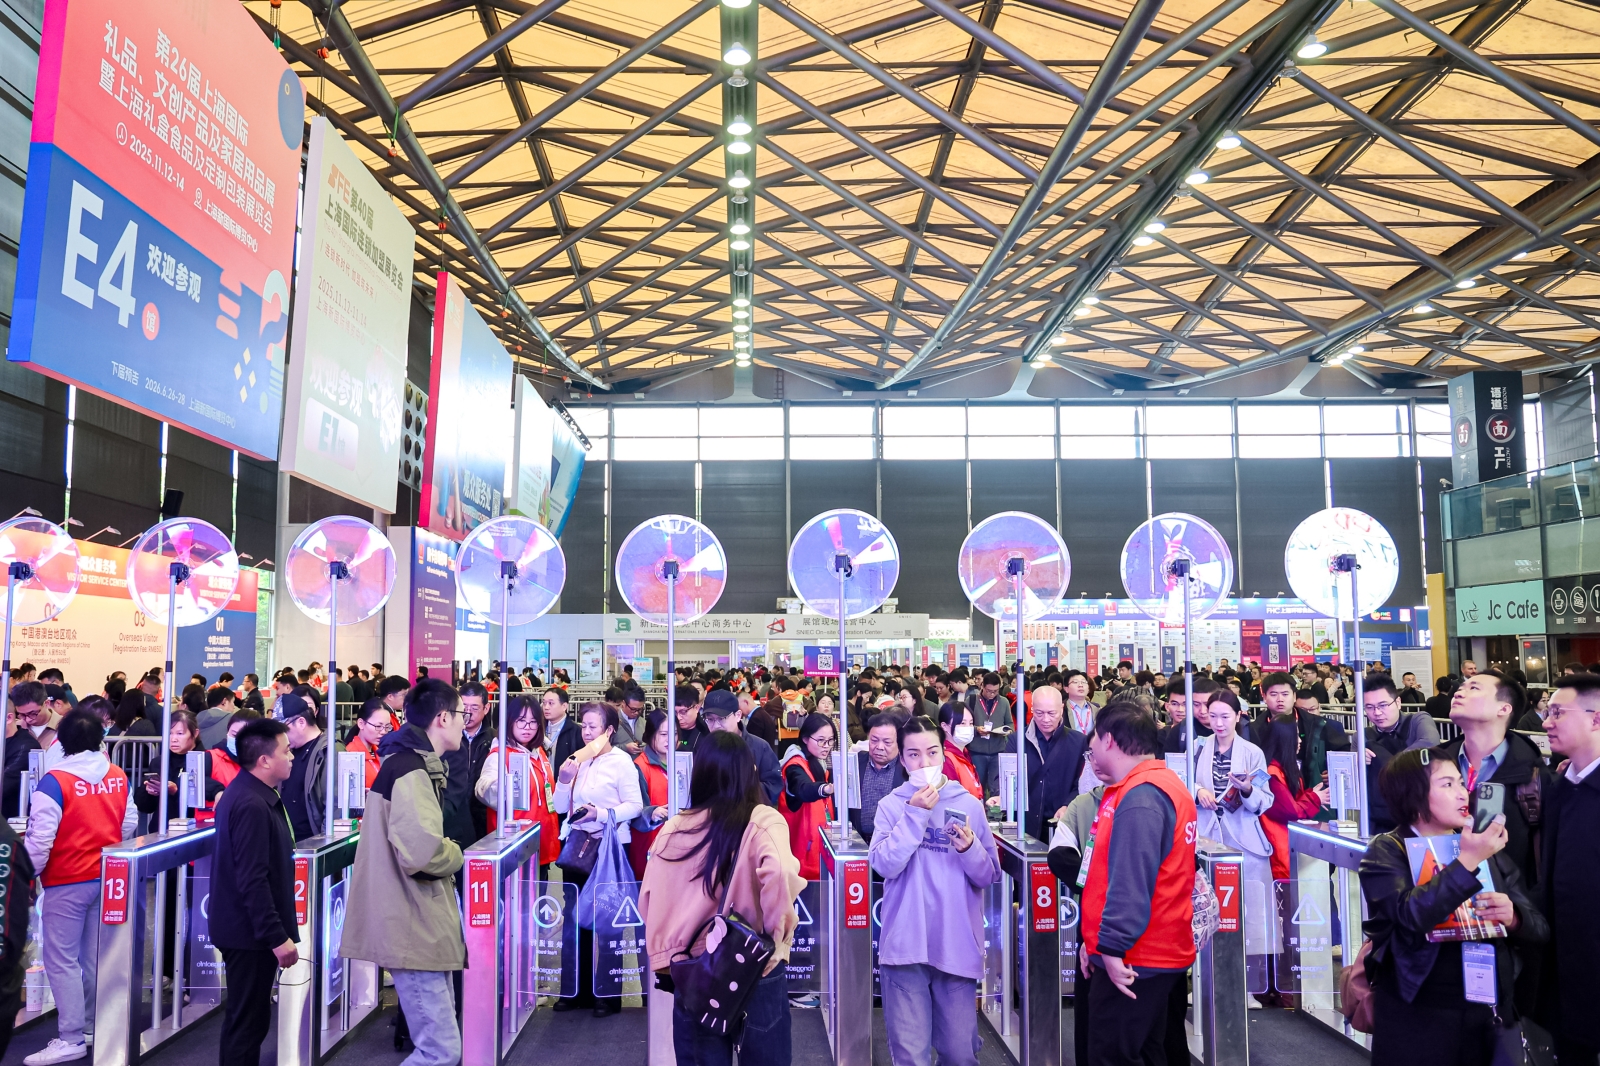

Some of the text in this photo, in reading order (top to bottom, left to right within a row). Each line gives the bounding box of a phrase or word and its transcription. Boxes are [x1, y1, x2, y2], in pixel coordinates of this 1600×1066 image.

[155, 28, 248, 146] 第26届上海国际
[103, 20, 276, 208] 礼品、文创产品及家居用品展
[99, 58, 273, 235] 暨上海礼盒食品及定制包装展览会
[130, 135, 185, 191] 2025.11.12-14
[350, 187, 374, 231] 第40届
[204, 199, 258, 253] 上海新国际博览中心
[61, 179, 138, 328] E4
[325, 194, 403, 293] 上海国际连锁加盟展览会
[146, 243, 202, 303] 欢迎参观
[318, 276, 367, 327] 2025.11.12-11.14
[146, 310, 155, 333] 馆
[111, 361, 139, 386] 下届预告
[144, 377, 186, 406] 2026.6.26-28
[463, 468, 491, 511] 观众服务处
[89, 576, 108, 585] SERVICE
[109, 578, 127, 587] CENTER
[134, 610, 145, 627] 03
[1487, 600, 1502, 620] Jc
[1506, 599, 1539, 620] Cafe
[21, 627, 77, 640] 中国港澳台地区观众
[216, 617, 224, 631] 01
[119, 633, 158, 642] Overseas Visitor
[105, 878, 125, 900] 13
[471, 881, 488, 903] 11
[848, 882, 864, 904] 9
[1037, 886, 1052, 908] 8
[1219, 886, 1235, 907] 7
